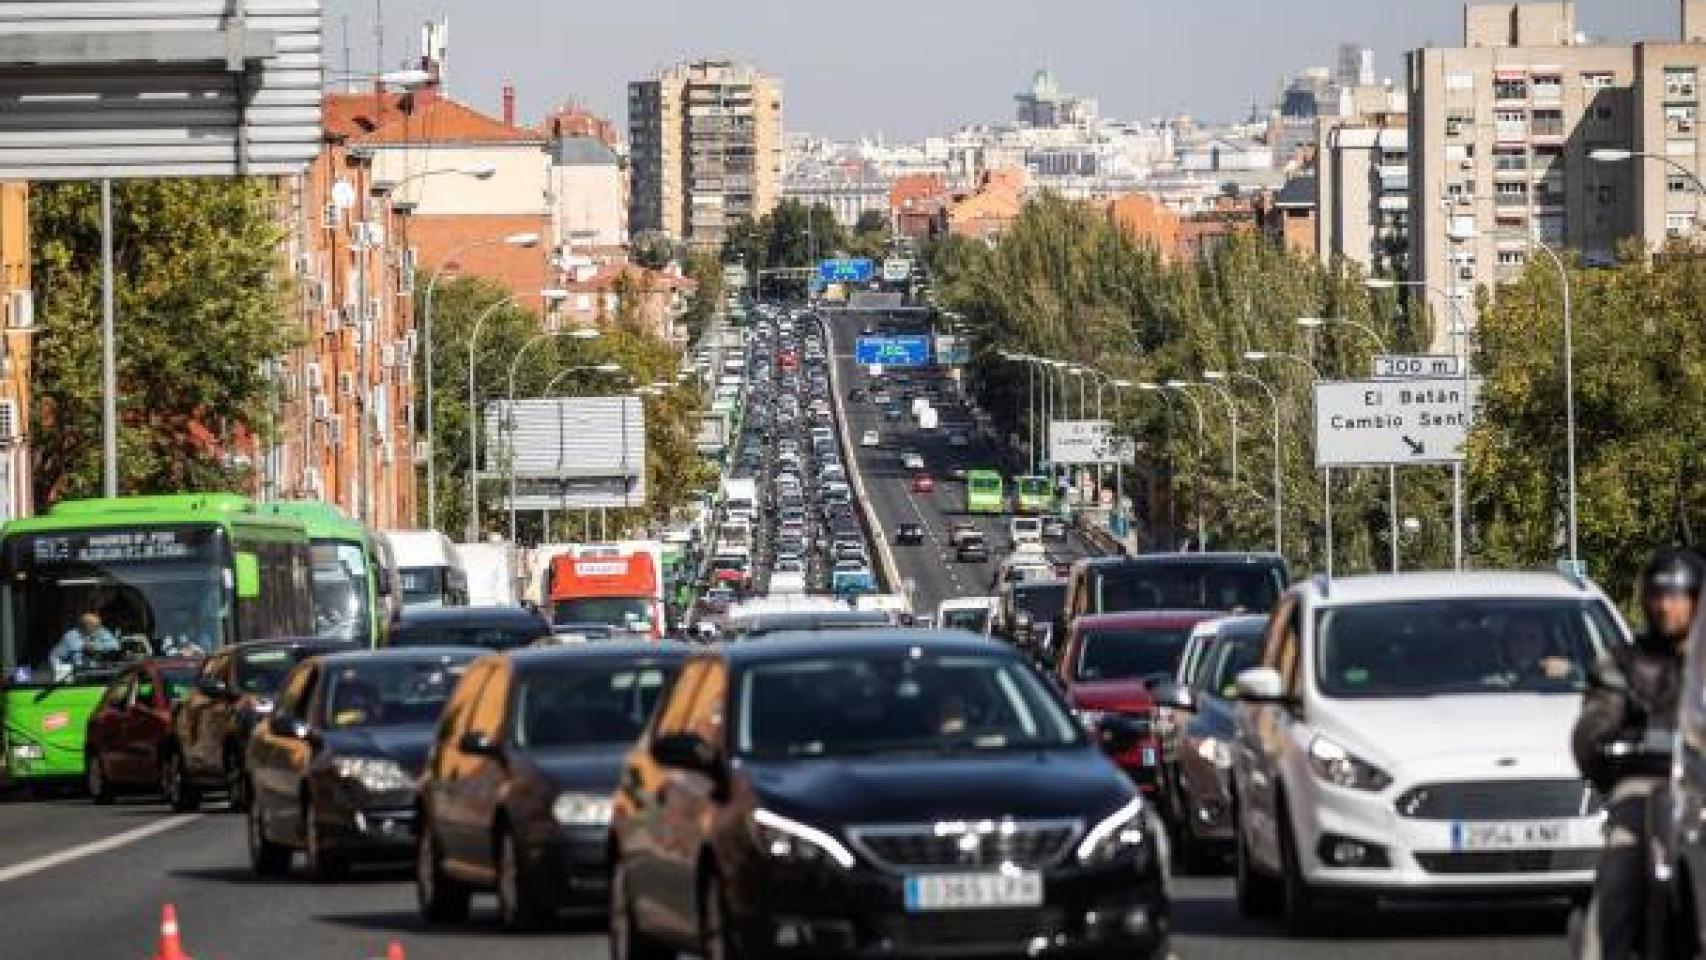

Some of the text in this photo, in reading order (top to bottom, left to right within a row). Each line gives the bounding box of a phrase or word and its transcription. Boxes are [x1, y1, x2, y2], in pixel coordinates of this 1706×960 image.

[1384, 359, 1422, 373] 300
[1365, 390, 1382, 406] El
[1331, 413, 1403, 428] Cambio
